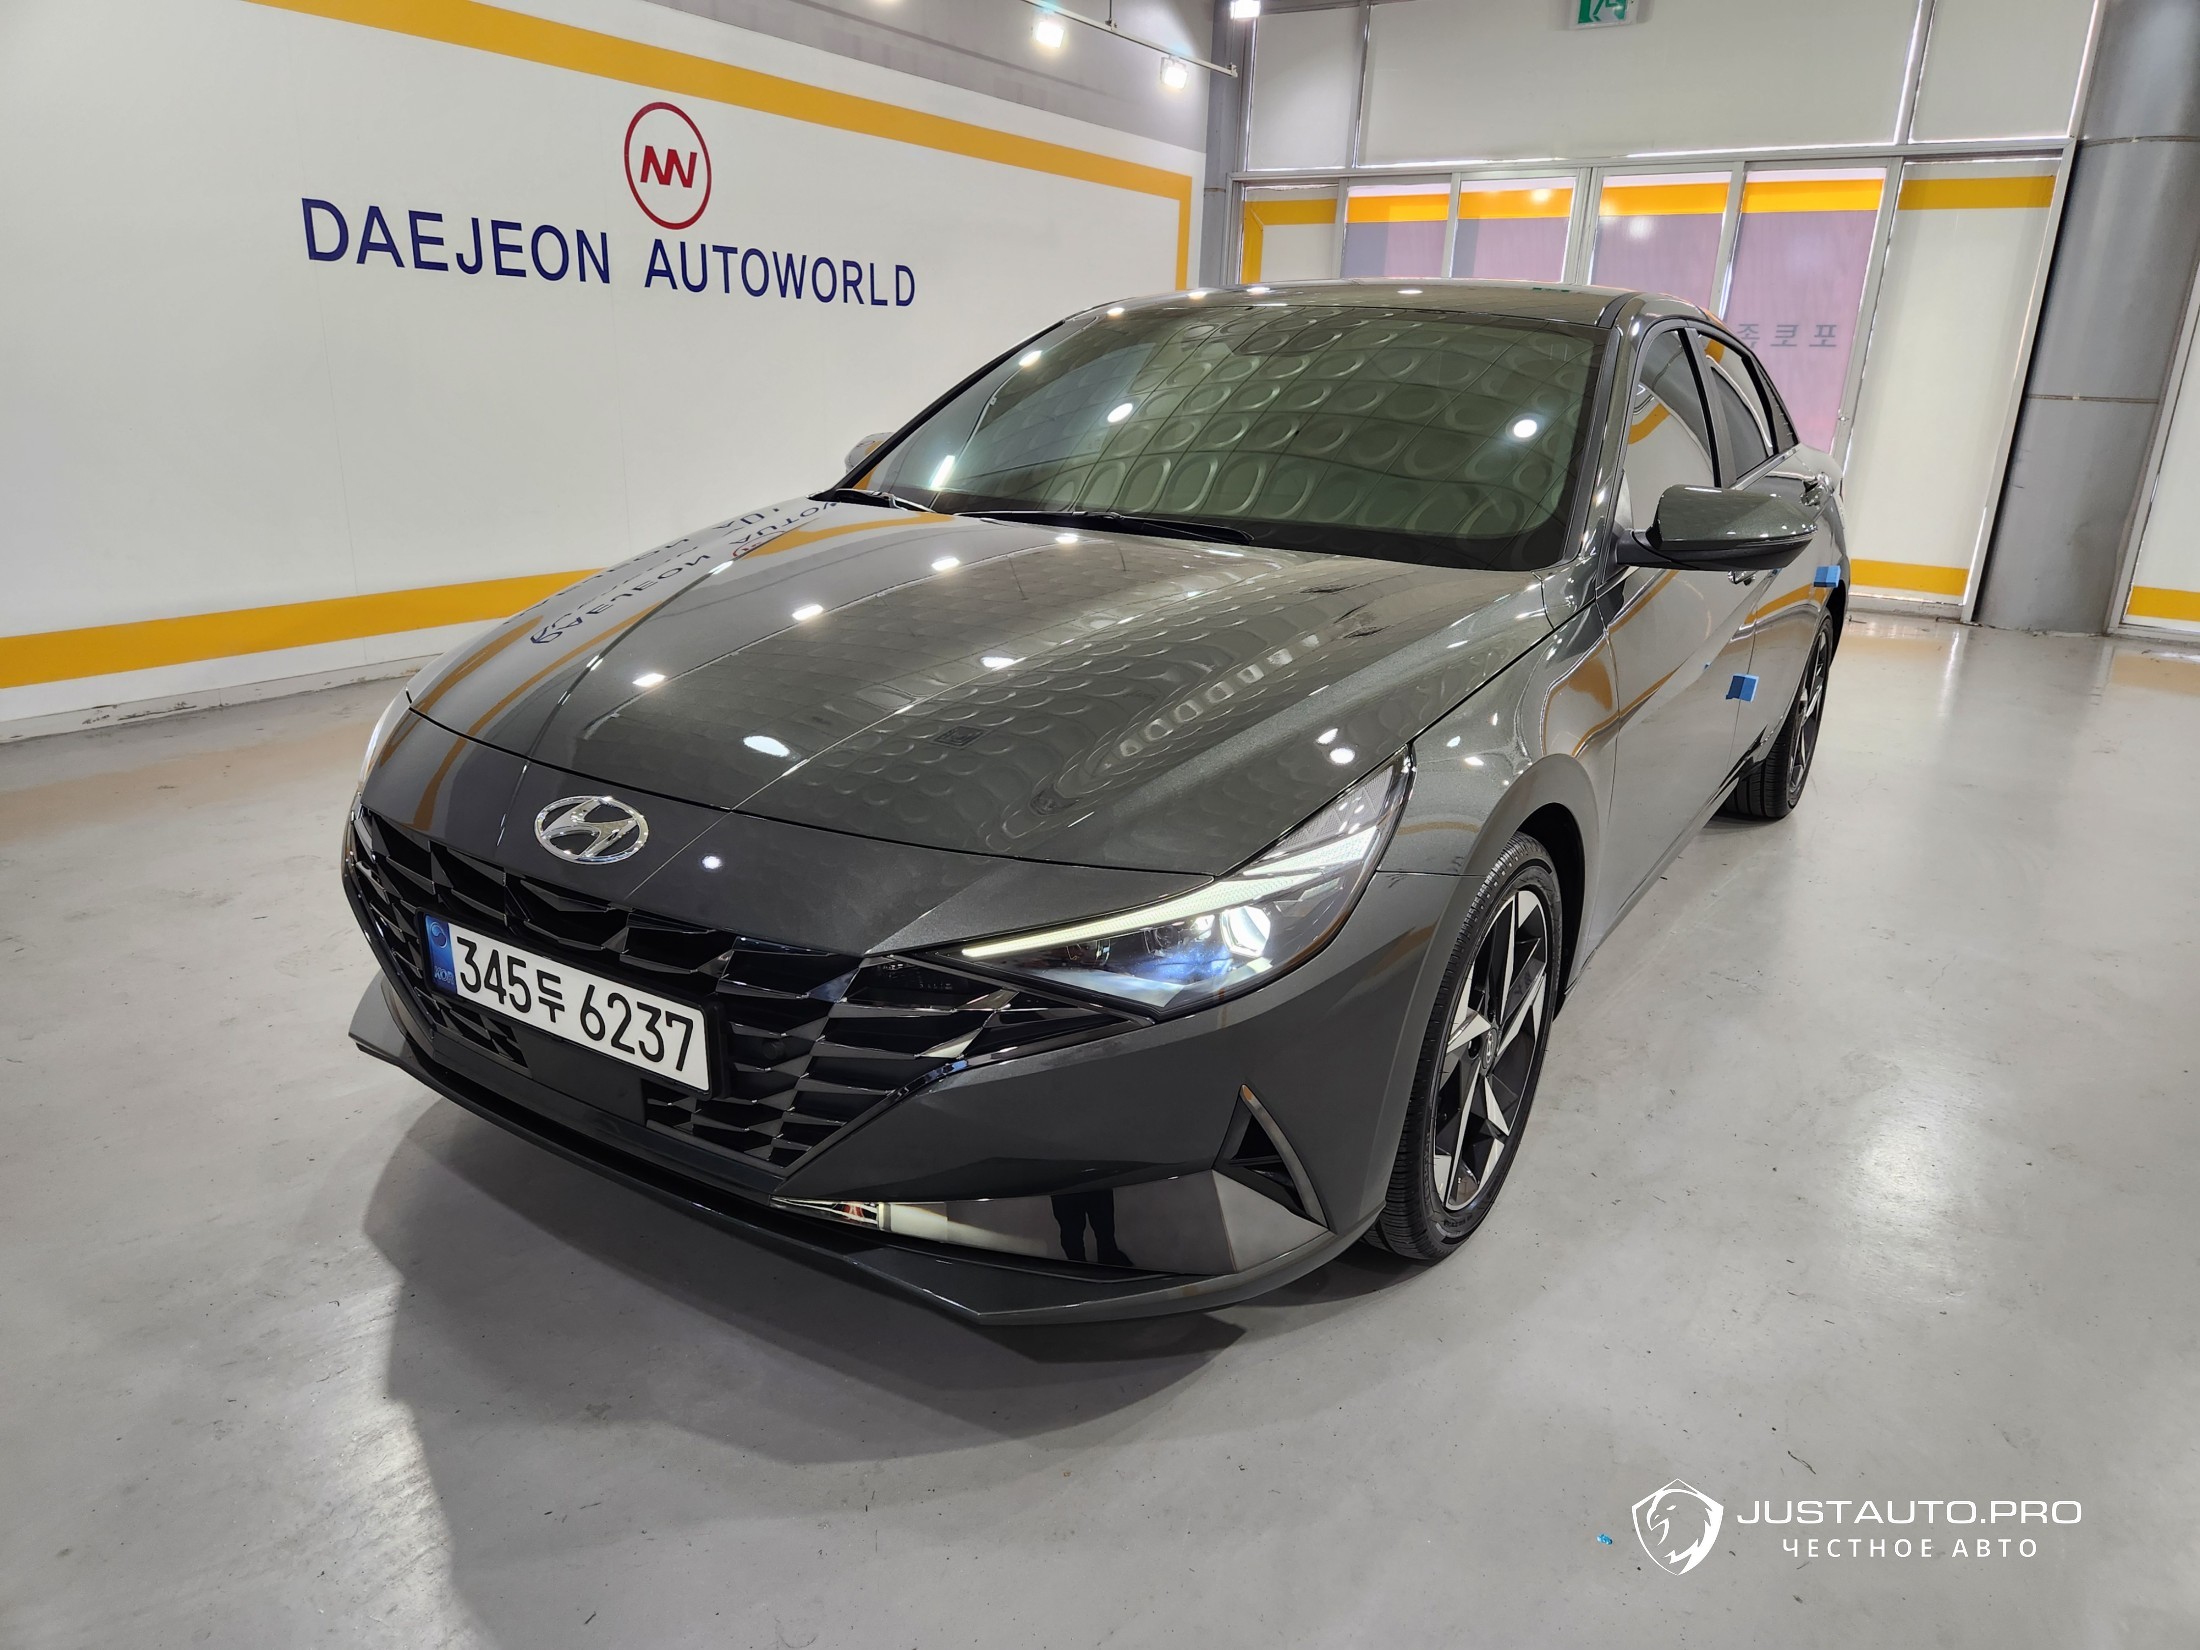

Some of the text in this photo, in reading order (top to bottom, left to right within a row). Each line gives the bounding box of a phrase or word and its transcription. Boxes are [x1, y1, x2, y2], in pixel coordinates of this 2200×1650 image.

[301, 197, 916, 307] DAEJEON AUTOWORLD
[456, 936, 694, 1072] 345두 6237
